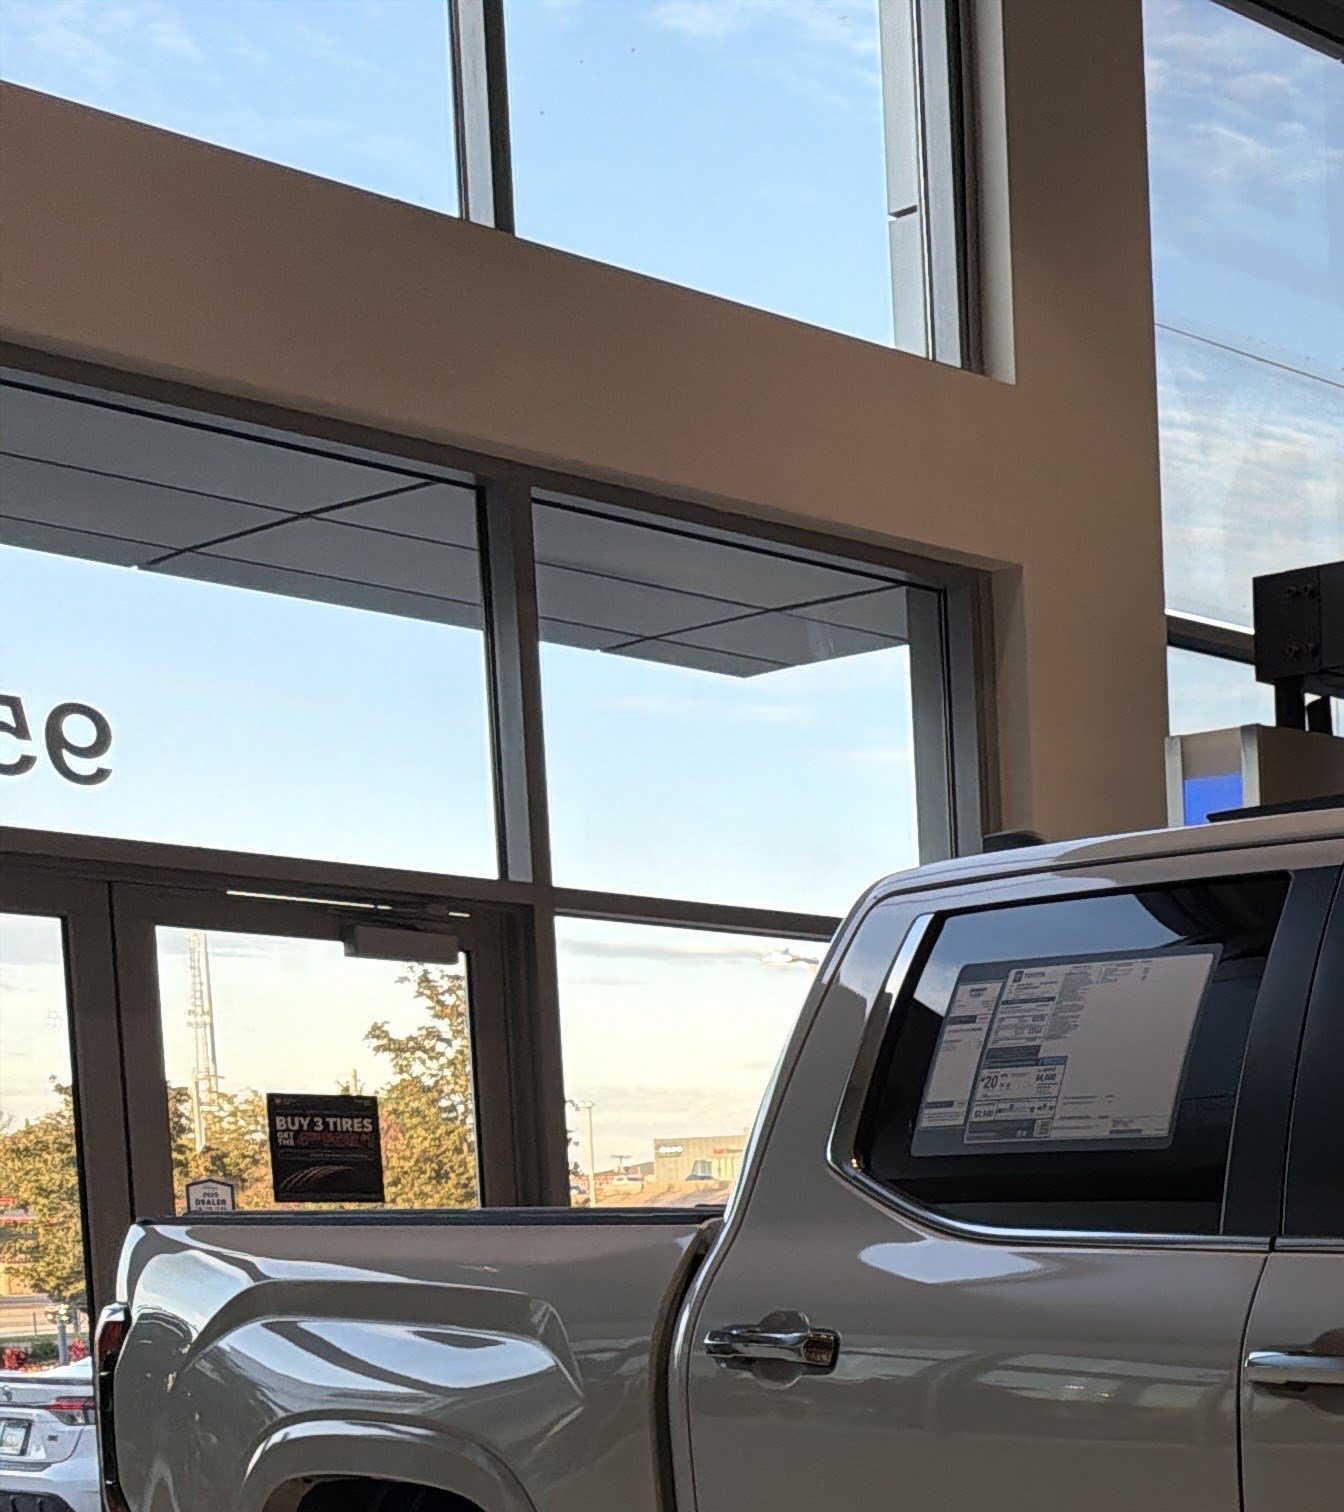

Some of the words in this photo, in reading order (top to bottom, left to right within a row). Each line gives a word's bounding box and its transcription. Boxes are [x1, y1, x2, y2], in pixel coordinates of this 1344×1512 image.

[276, 1116, 310, 1131] BUY
[313, 1117, 324, 1132] 3
[325, 1117, 373, 1133] TIRES
